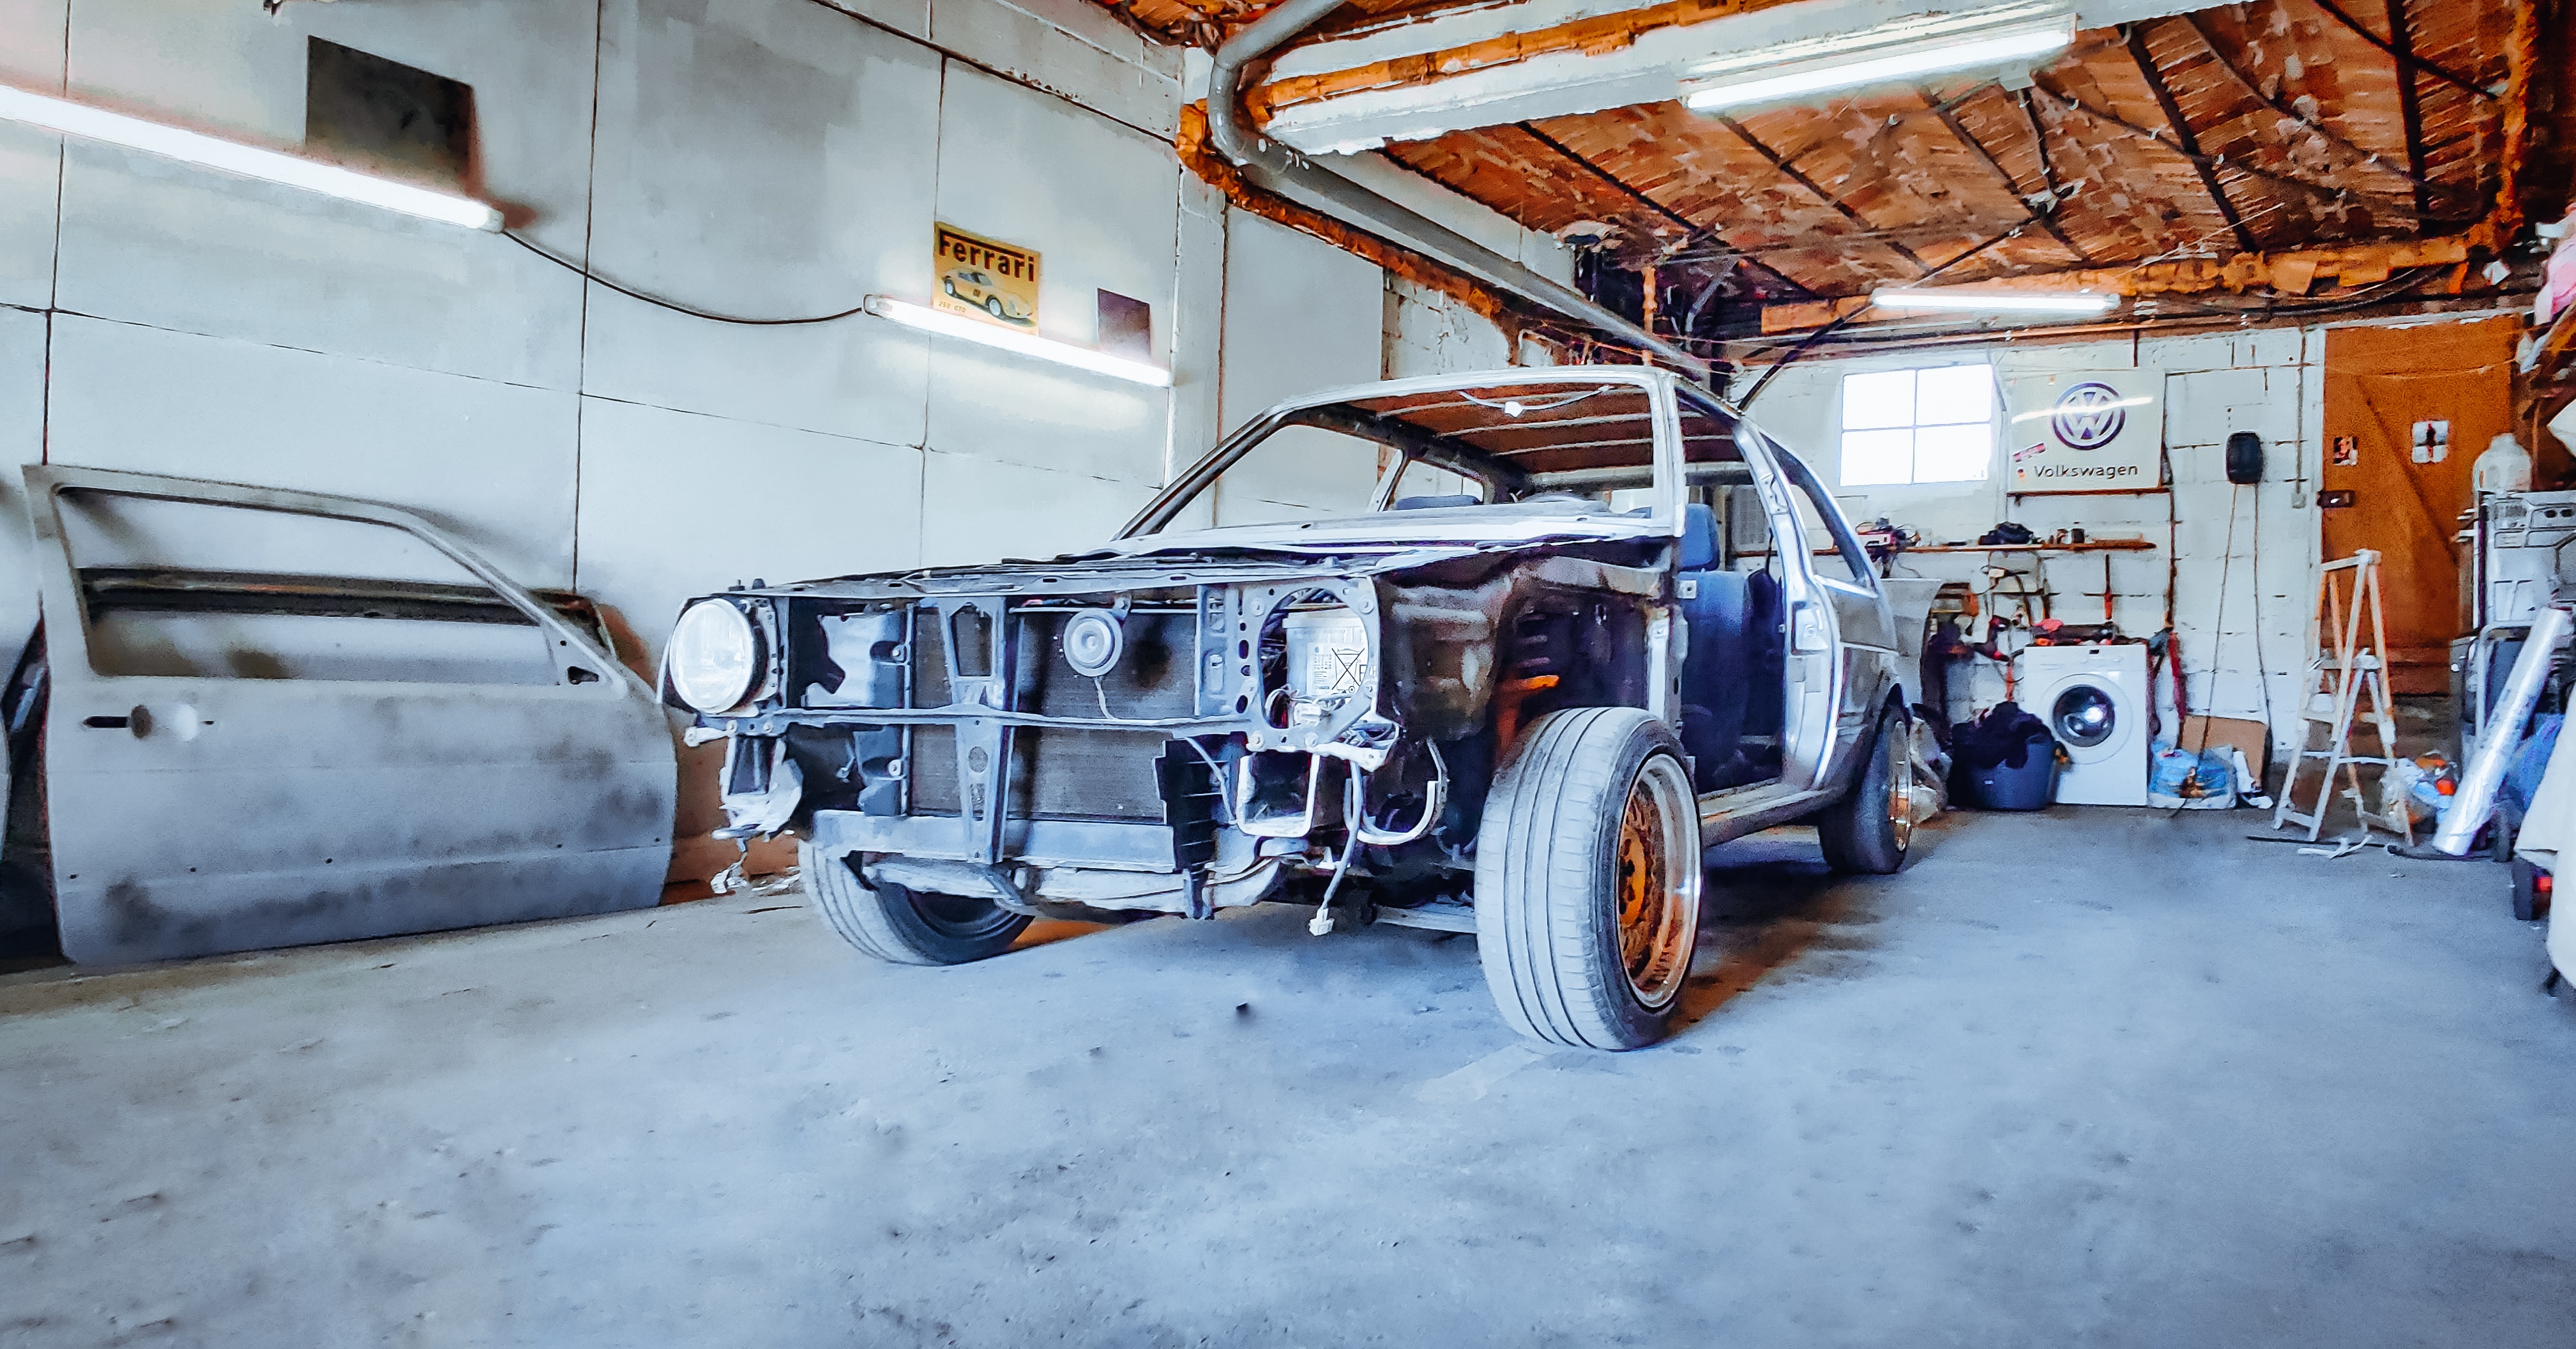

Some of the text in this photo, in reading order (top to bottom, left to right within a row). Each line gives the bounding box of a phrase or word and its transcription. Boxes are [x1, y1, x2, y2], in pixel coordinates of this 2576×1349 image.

[939, 229, 1034, 282] Ferrari
[954, 305, 966, 313] GTO
[2034, 464, 2138, 479] Volkswagen
